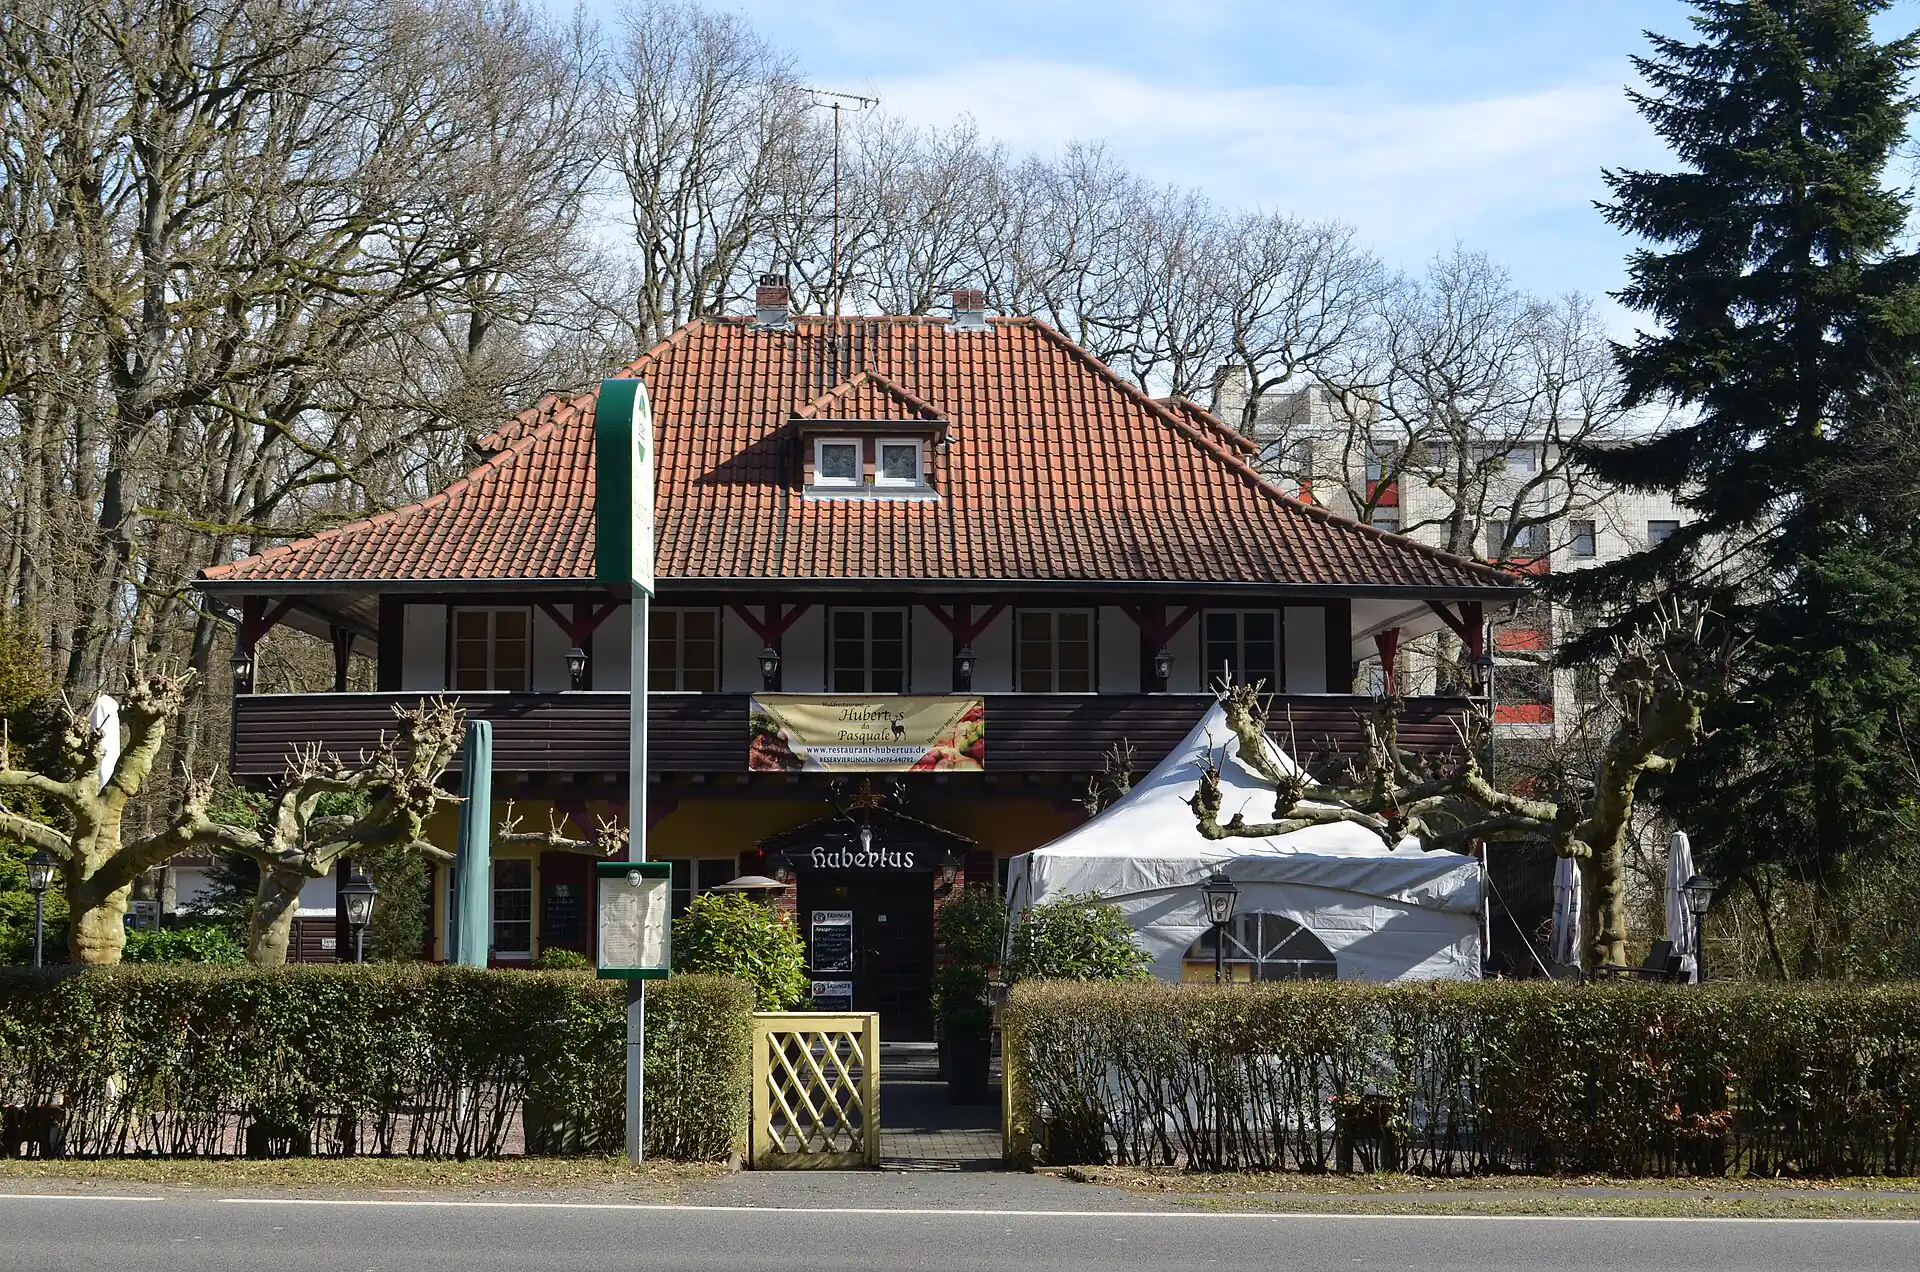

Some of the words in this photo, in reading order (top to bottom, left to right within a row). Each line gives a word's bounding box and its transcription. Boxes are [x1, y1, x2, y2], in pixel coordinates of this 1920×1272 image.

[860, 721, 870, 730] da
[837, 727, 890, 745] Pasquale
[806, 745, 926, 754] www.restaurant-hubertus.de
